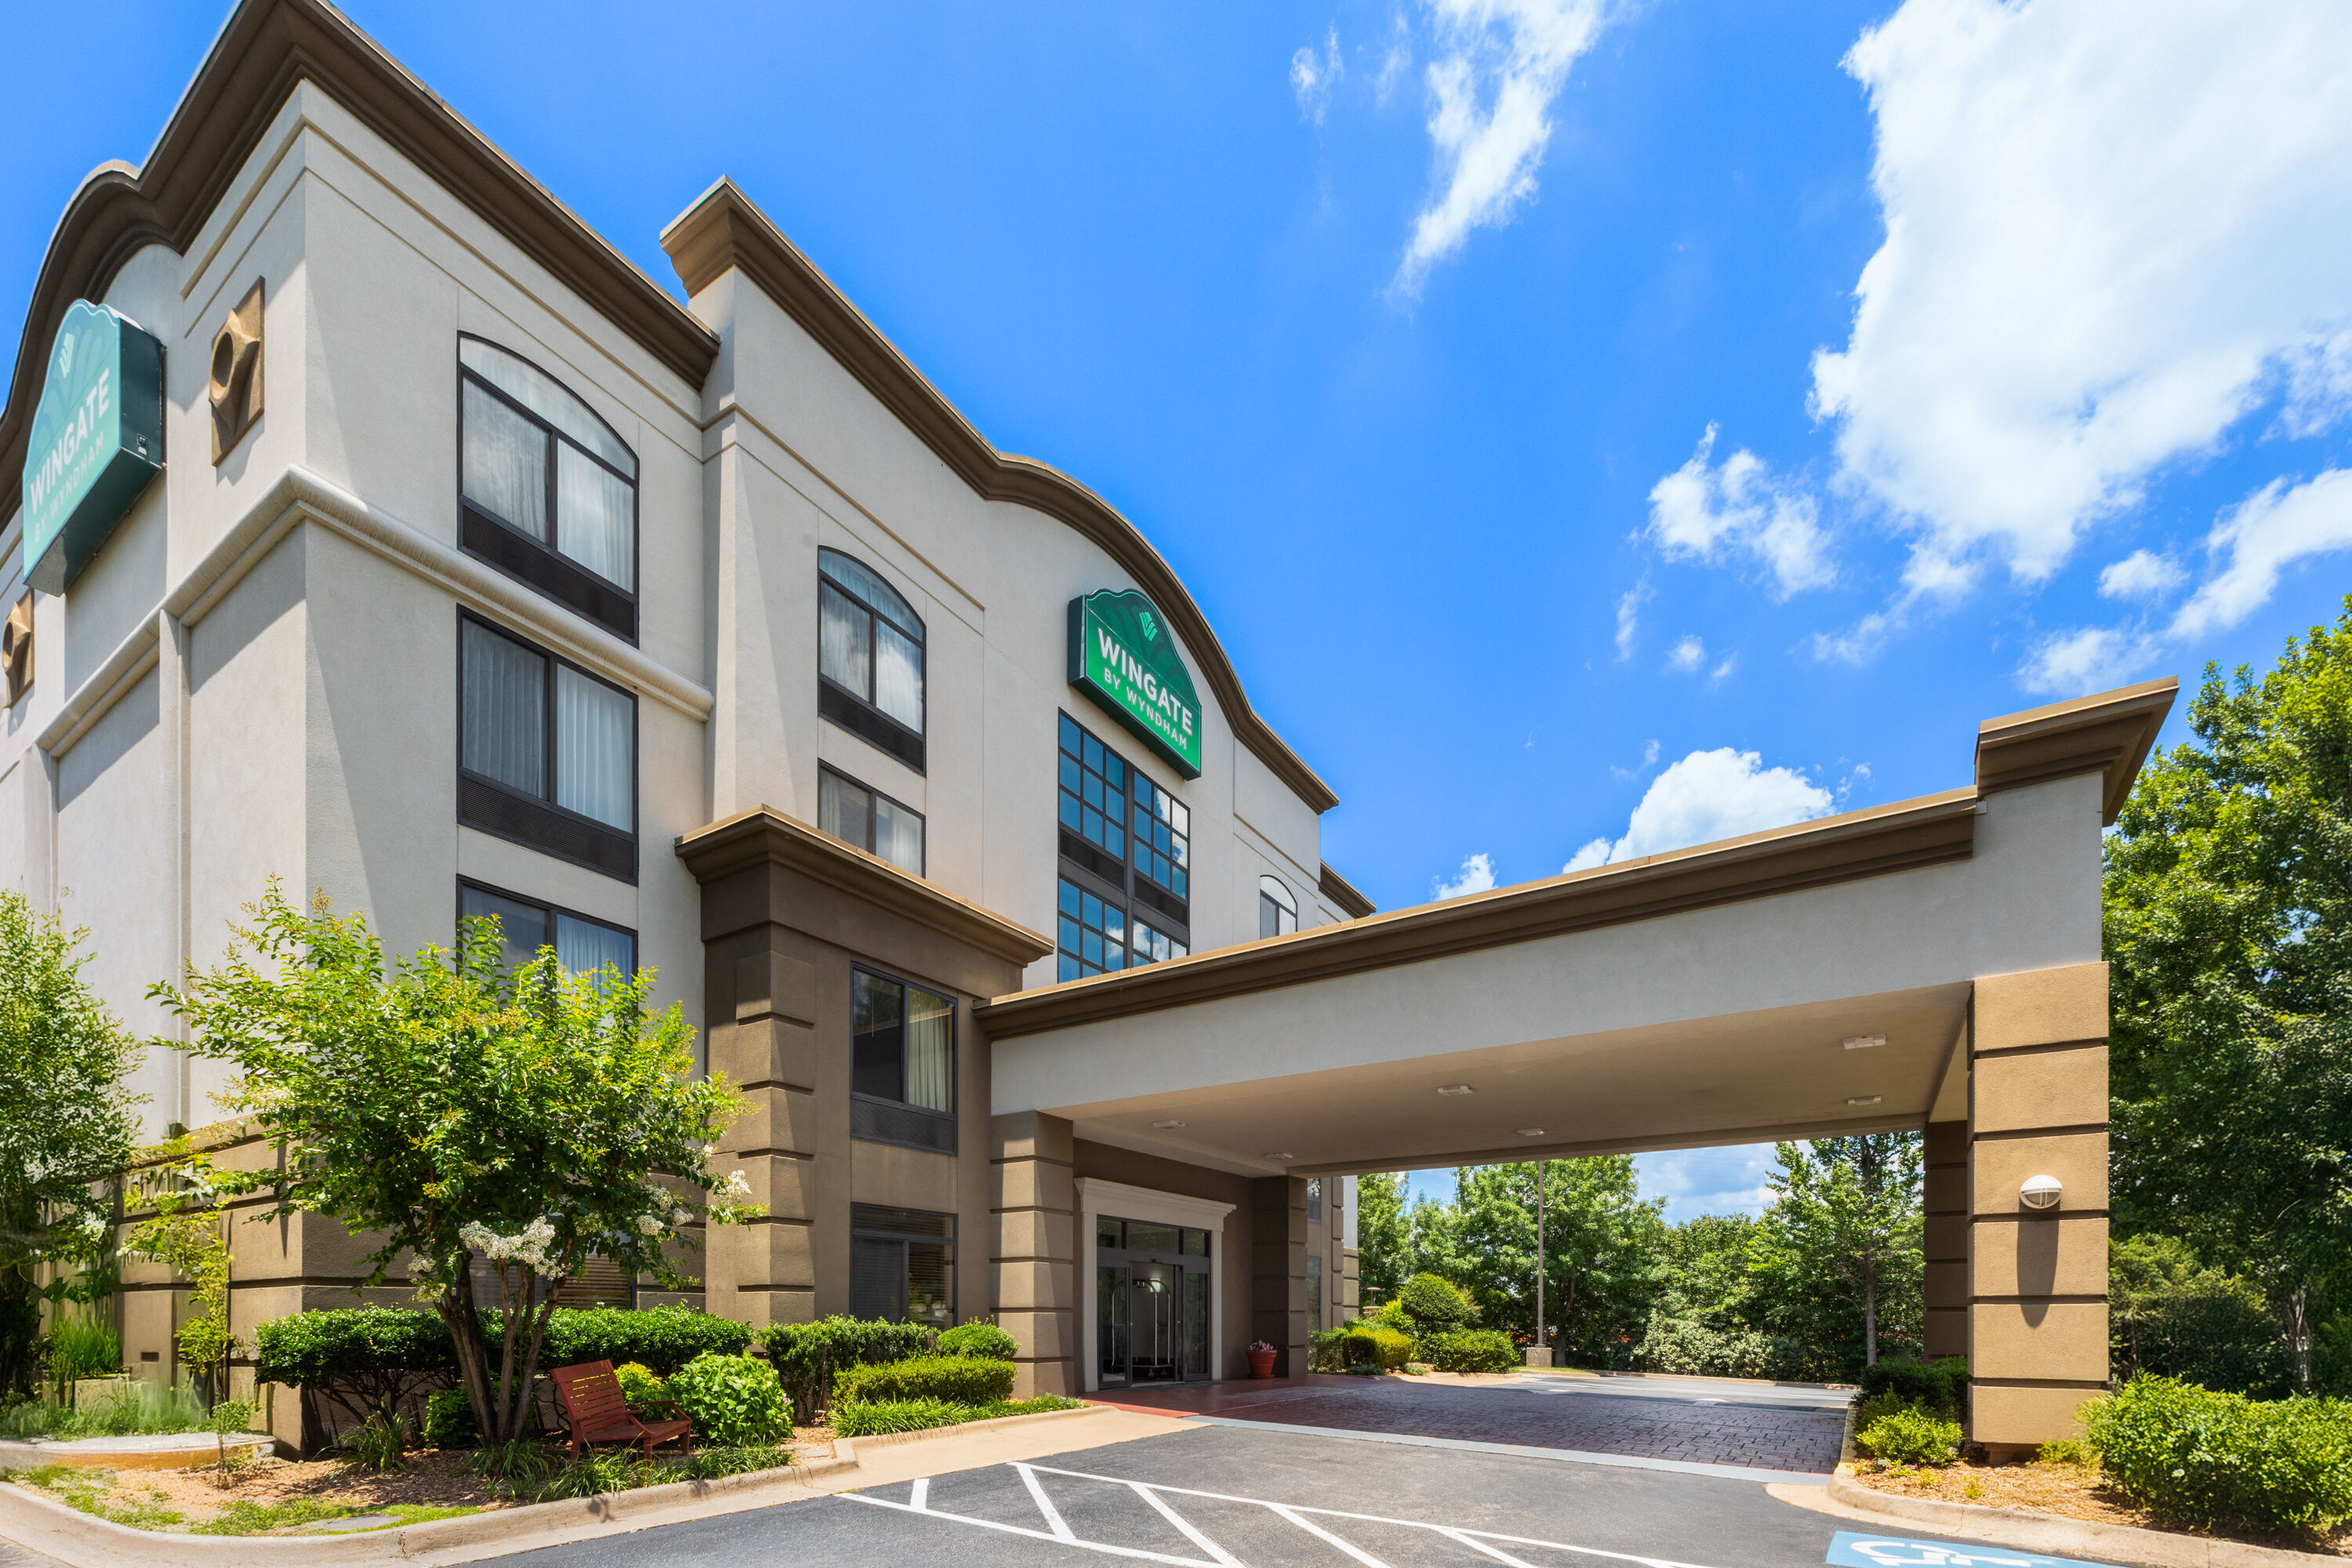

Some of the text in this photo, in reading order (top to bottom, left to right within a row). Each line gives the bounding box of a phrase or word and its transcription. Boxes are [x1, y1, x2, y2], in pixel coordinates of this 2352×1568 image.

[30, 368, 110, 514] WINGATE
[34, 430, 104, 543] BY WYNDHAM
[1098, 627, 1193, 735] WINGATE
[1104, 667, 1187, 750] BY WYNDHAM
